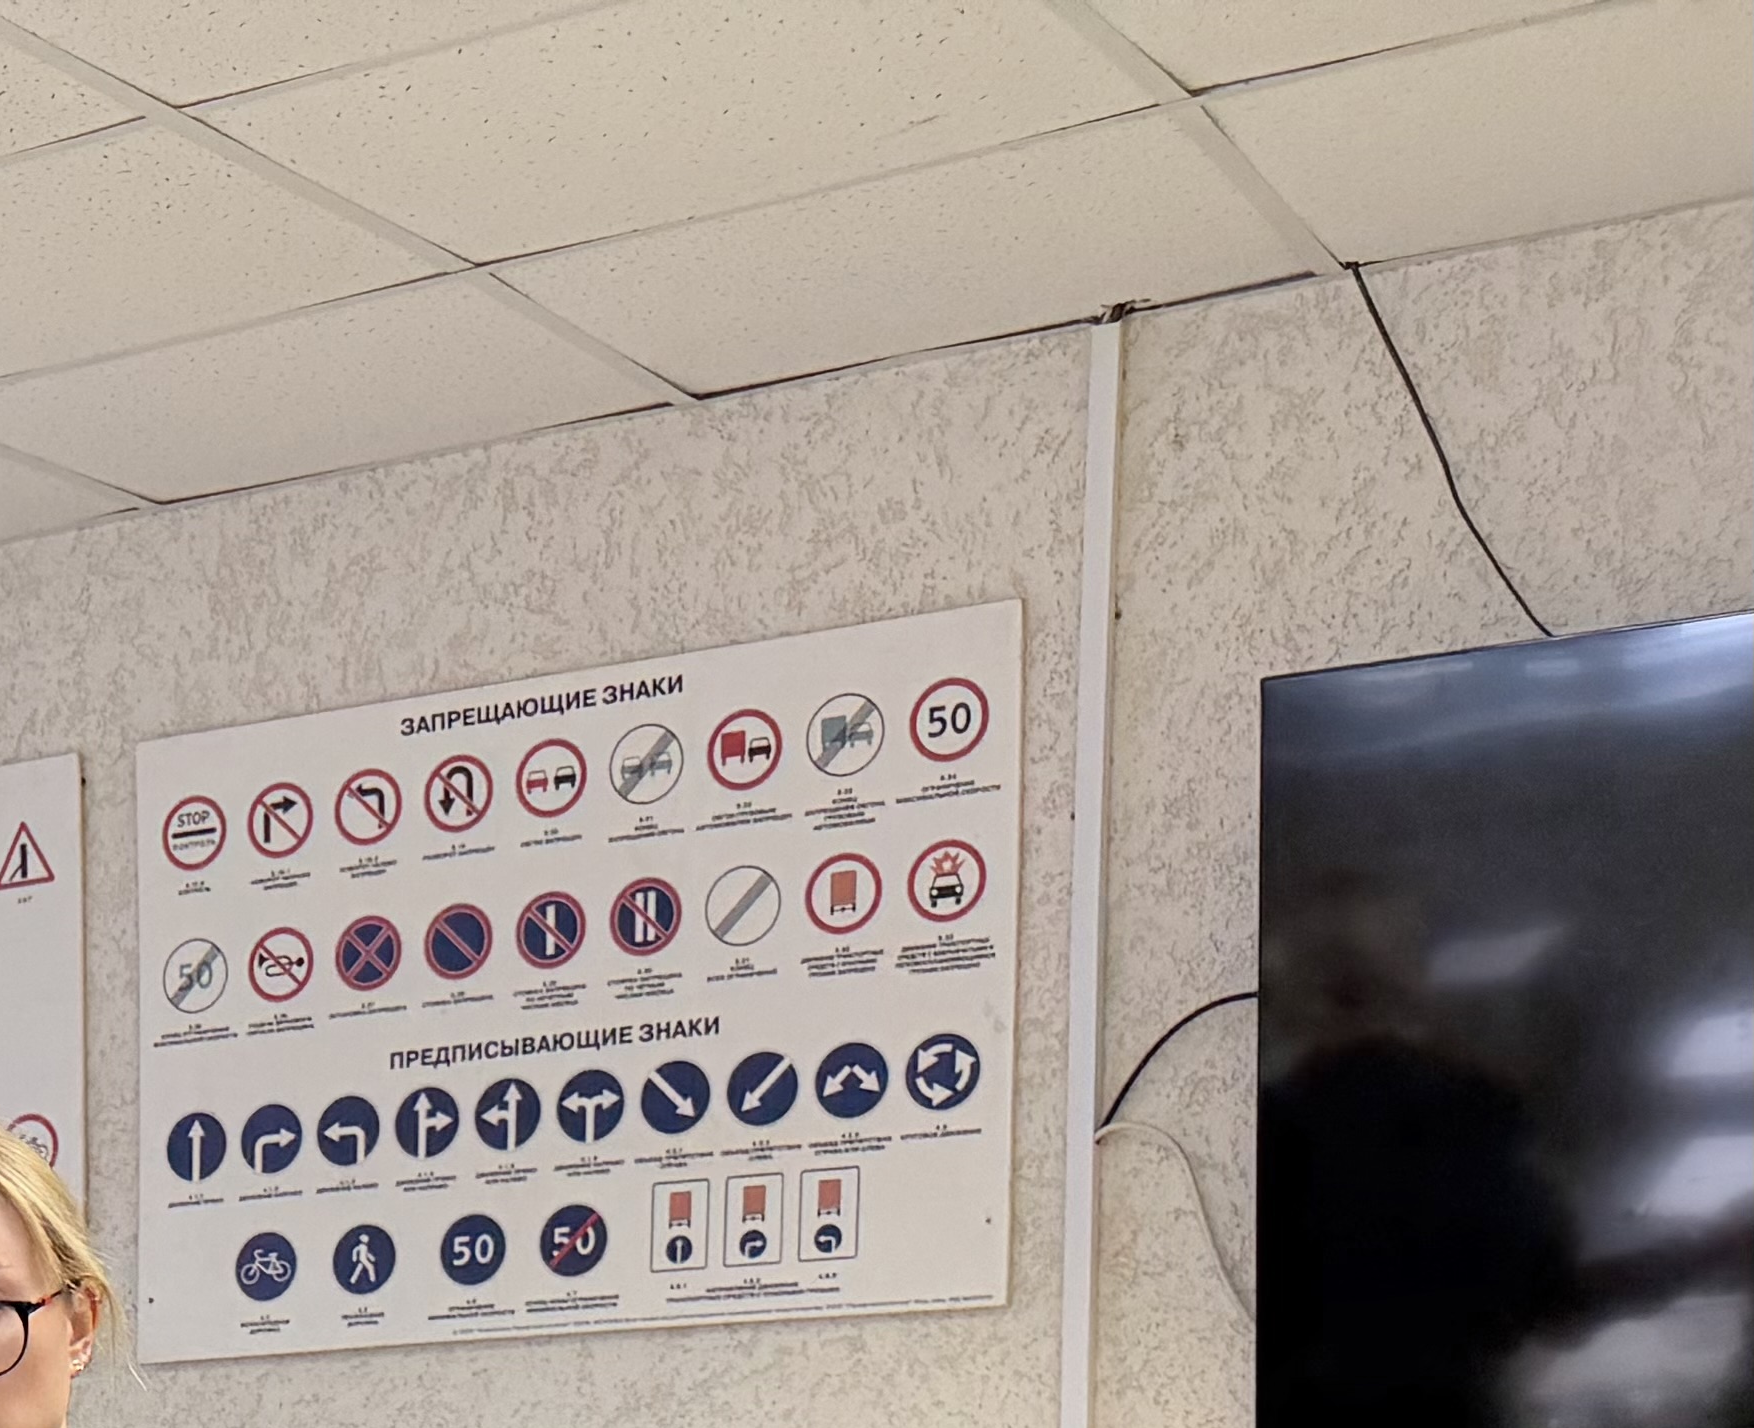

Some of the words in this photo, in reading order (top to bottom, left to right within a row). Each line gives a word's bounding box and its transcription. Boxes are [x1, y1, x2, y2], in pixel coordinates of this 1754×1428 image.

[400, 688, 597, 738] ЗАПРЕЩАЮЩИЕ
[602, 674, 684, 706] ЗНАКИ
[928, 702, 972, 738] 50
[177, 809, 210, 828] STOP
[179, 960, 212, 991] 50
[390, 1025, 633, 1070] ПРЕДПИСЫВАЮЩИЕ
[638, 1016, 721, 1043] ЗНАКИ
[452, 1232, 494, 1267] 50
[552, 1226, 596, 1258] 50
